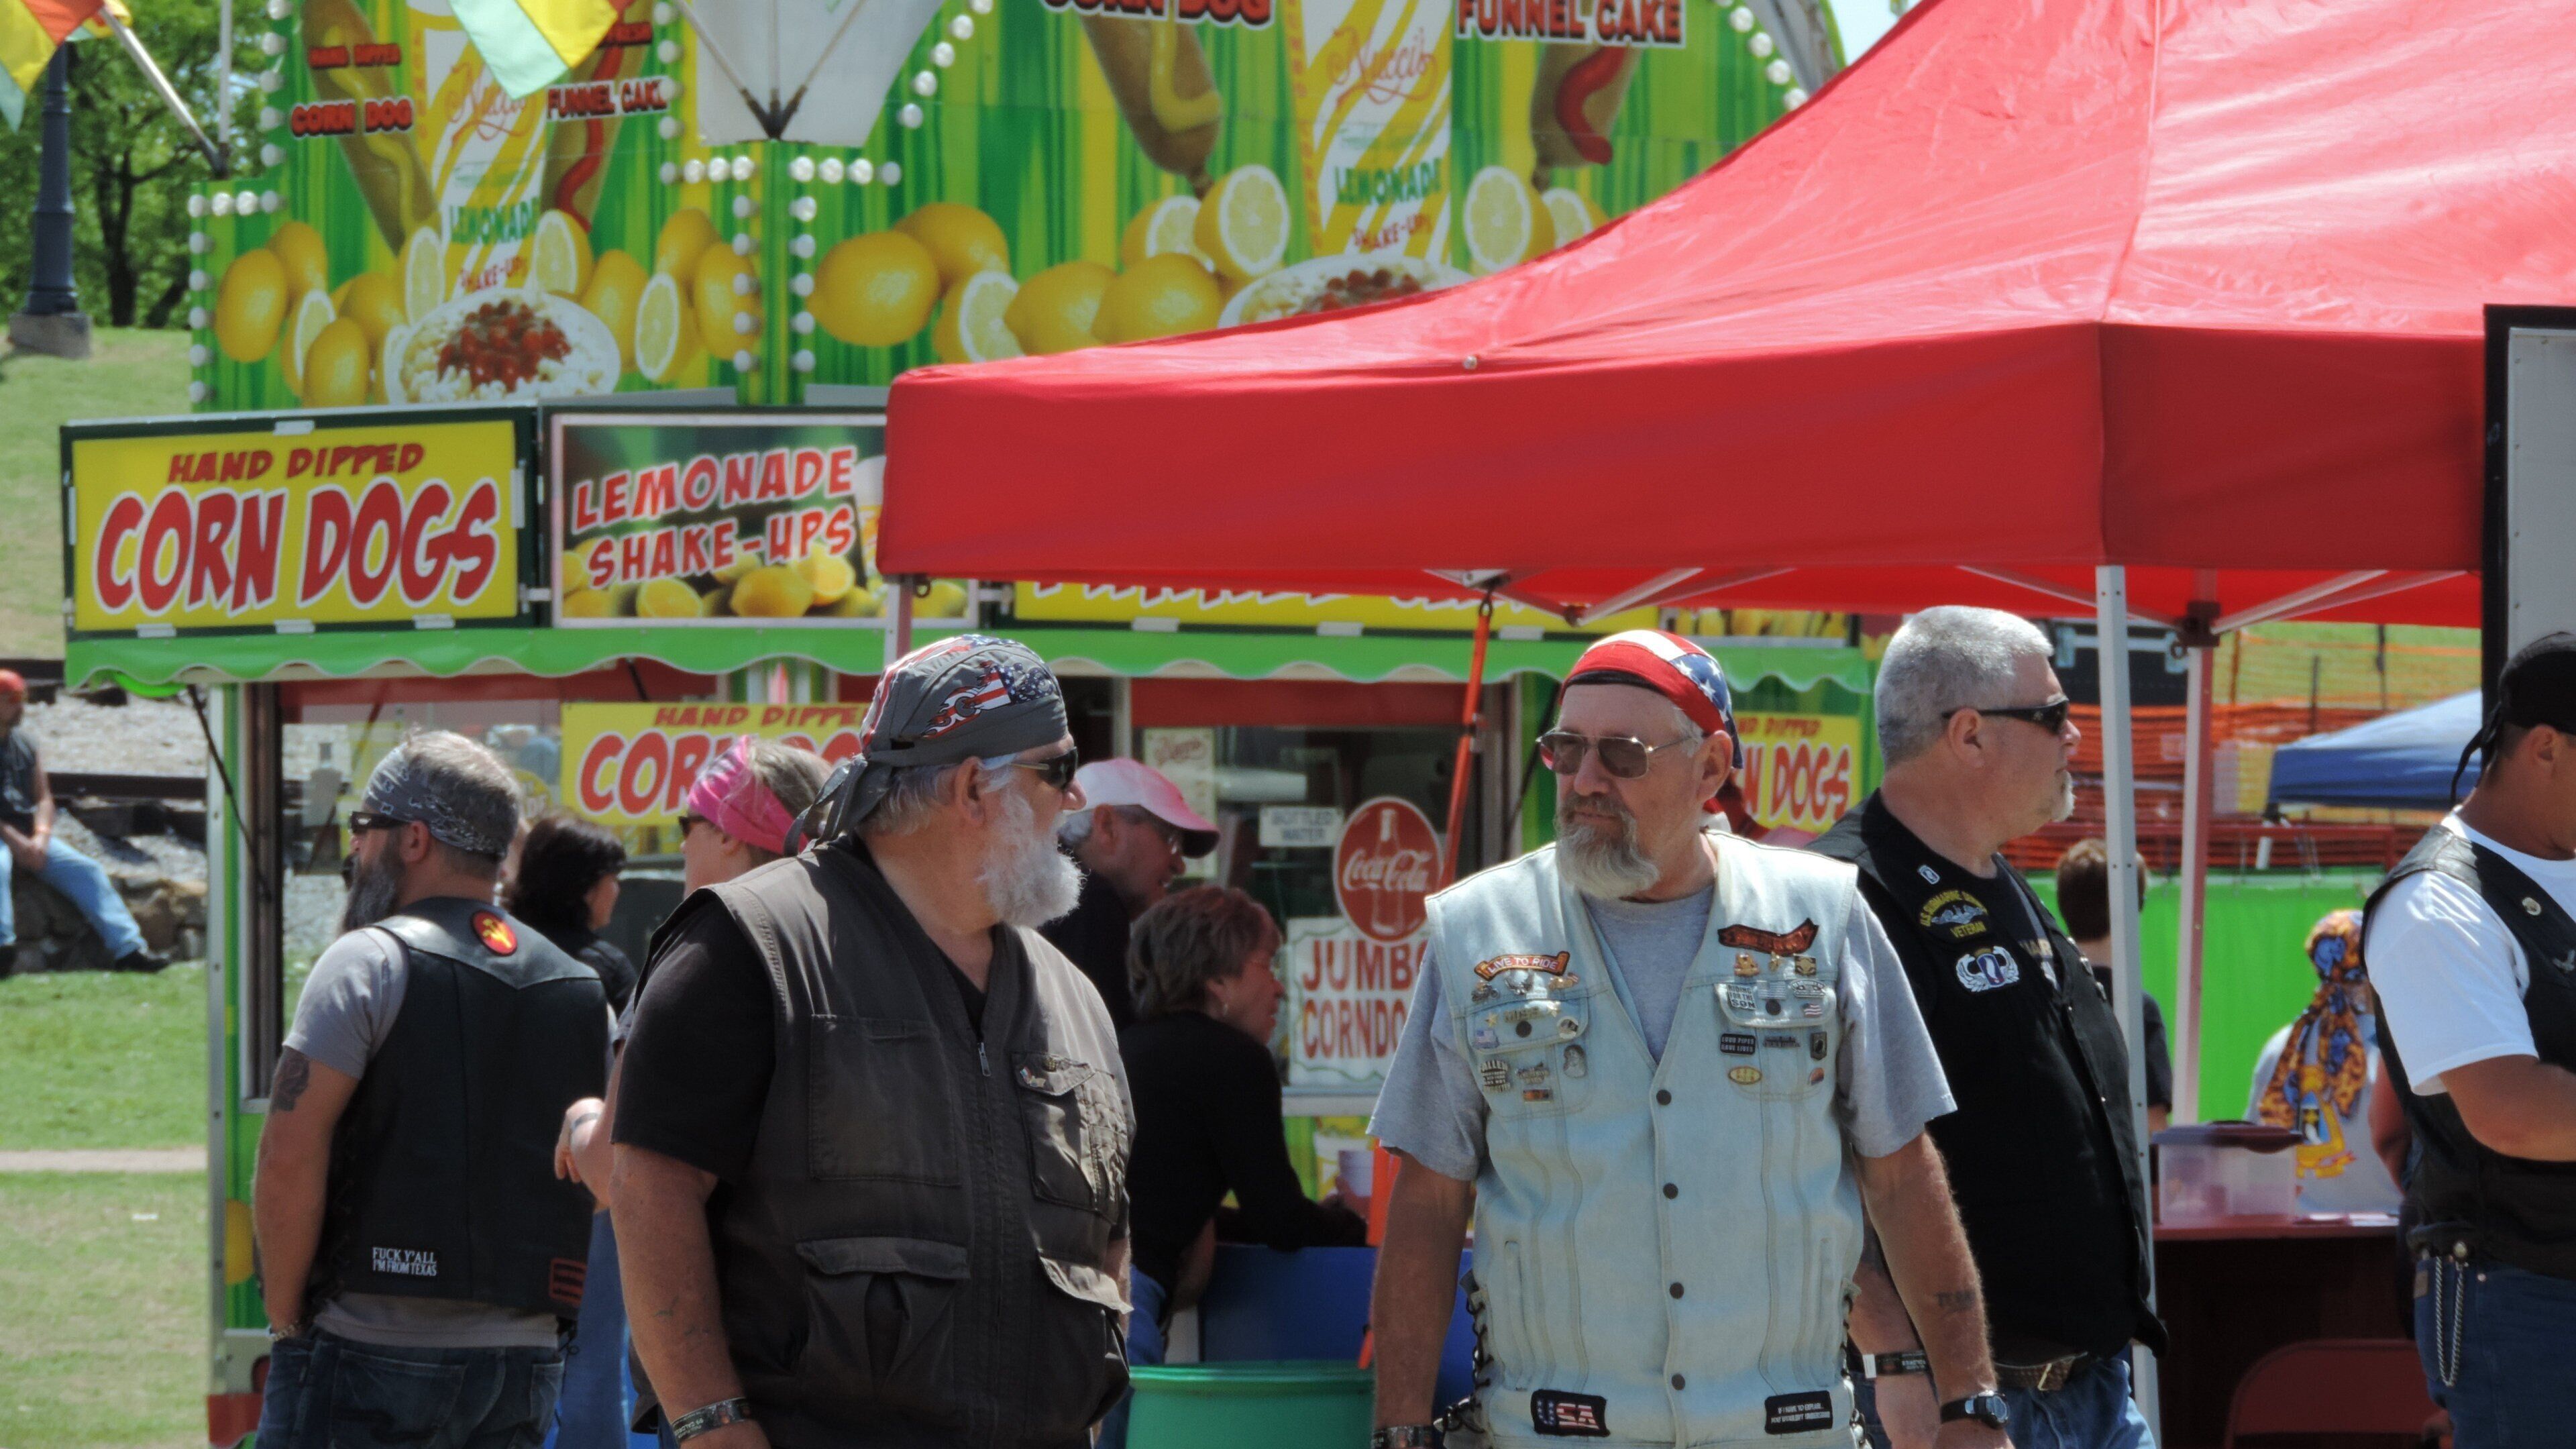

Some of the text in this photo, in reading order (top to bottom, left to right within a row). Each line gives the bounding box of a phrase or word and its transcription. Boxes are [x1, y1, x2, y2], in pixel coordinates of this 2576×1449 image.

[1457, 0, 1682, 44] FUNNEL CAKE
[547, 83, 616, 119] FUNNEL
[1334, 156, 1444, 206] LEMONADE
[166, 443, 425, 484] HAND DIPPED
[572, 445, 857, 533] LEMONADE
[95, 477, 498, 615] CORN DOGS
[588, 504, 856, 588] SHAKE-UPS
[655, 706, 749, 727] HAND
[578, 730, 737, 818] COR
[1769, 741, 1851, 823] DOGS
[1343, 847, 1433, 892] Coca-Cola
[1487, 957, 1558, 973] LIVE TO RIDE
[1303, 998, 1409, 1058] CORNDO
[373, 1247, 437, 1264] FUCK Y'ALL
[373, 1260, 437, 1277] I'M FROM TEXAS
[1537, 1399, 1599, 1430] USA
